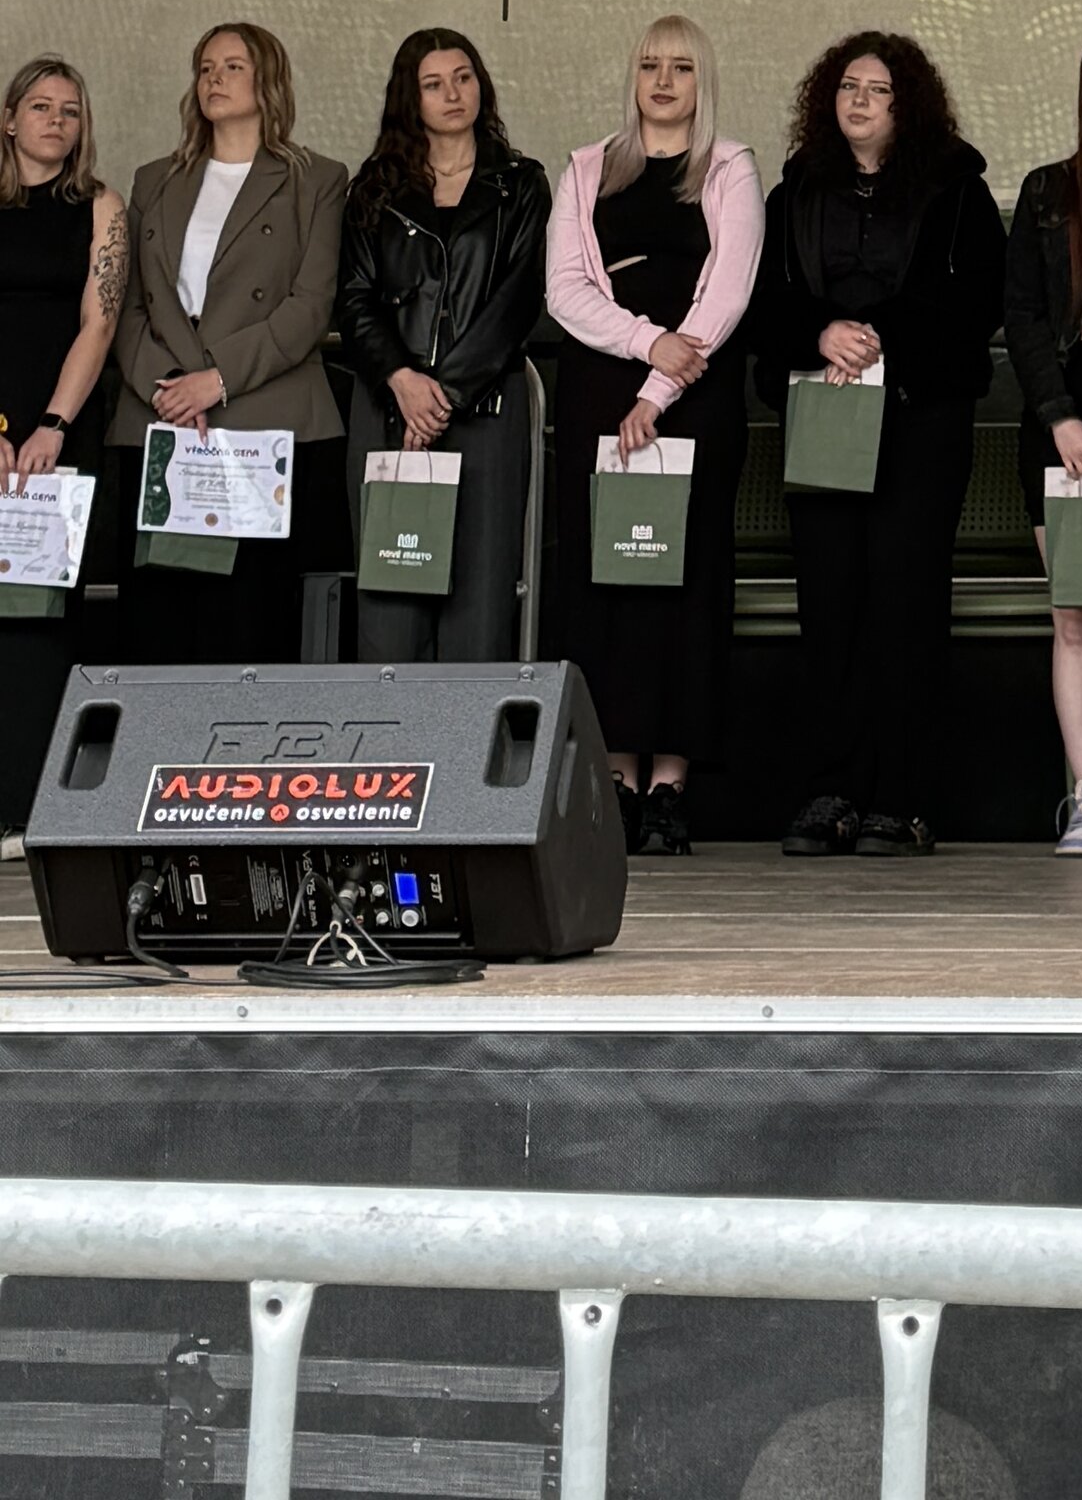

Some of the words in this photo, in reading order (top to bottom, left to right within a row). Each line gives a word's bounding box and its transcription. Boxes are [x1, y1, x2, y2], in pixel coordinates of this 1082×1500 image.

[161, 773, 417, 799] AUDIOLUX
[154, 804, 265, 822] ozvučenie
[295, 803, 412, 822] osvetlenie
